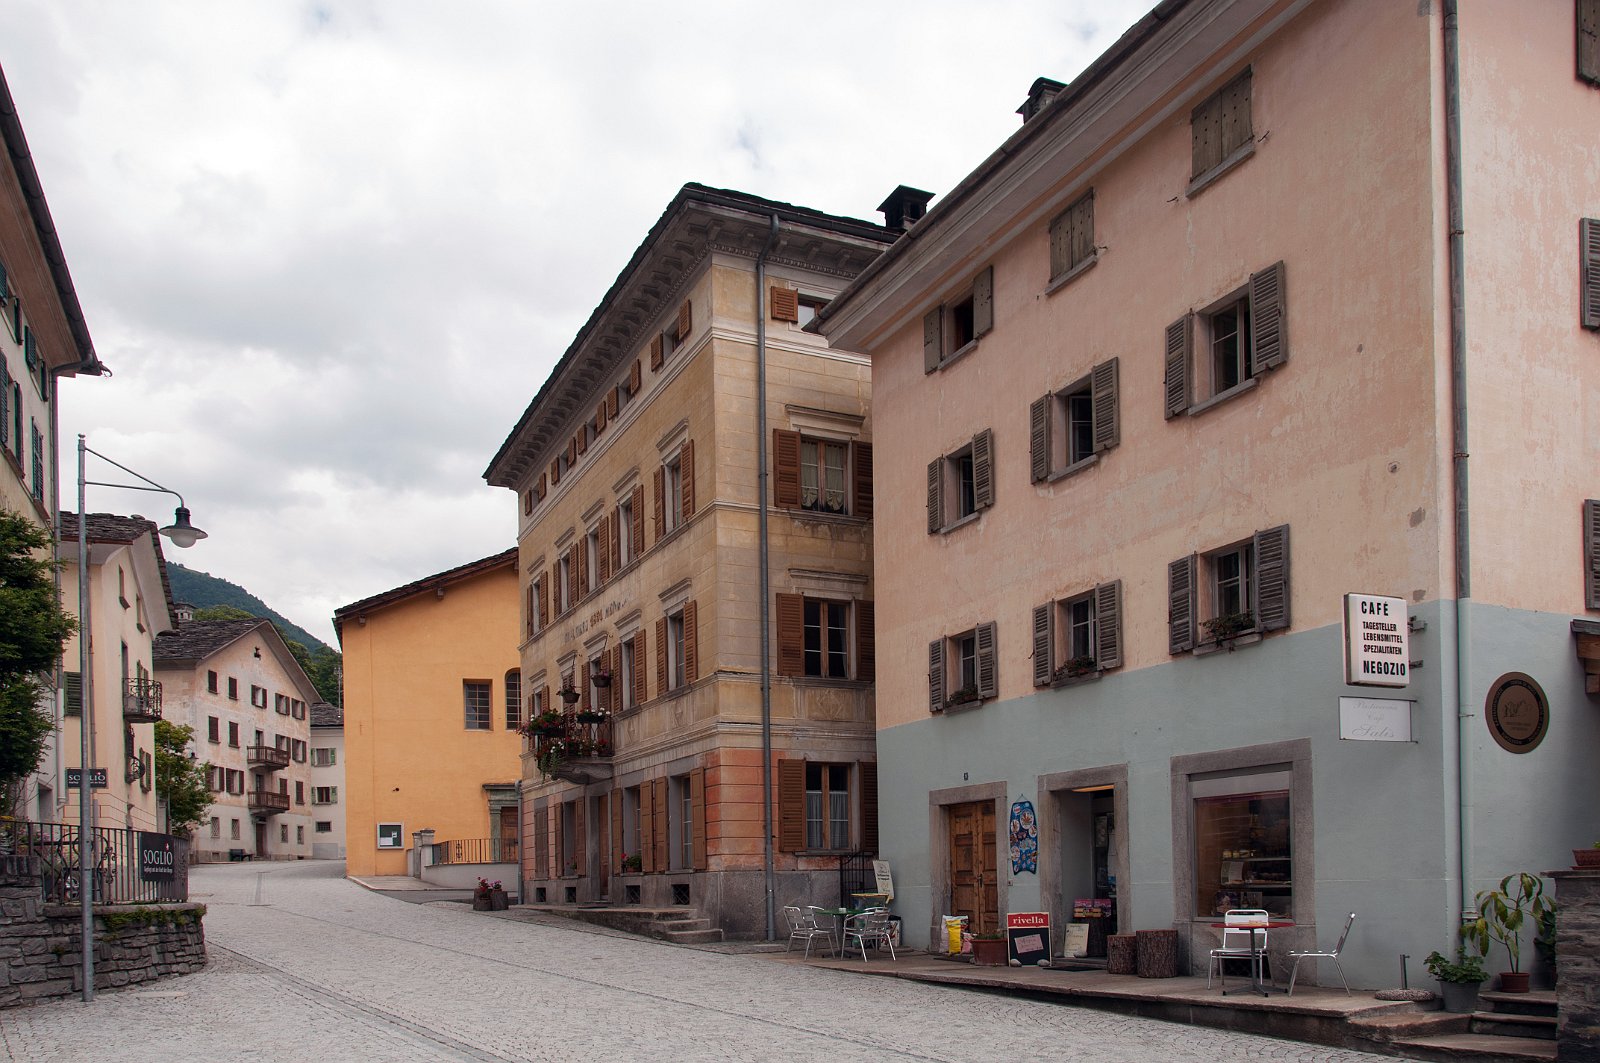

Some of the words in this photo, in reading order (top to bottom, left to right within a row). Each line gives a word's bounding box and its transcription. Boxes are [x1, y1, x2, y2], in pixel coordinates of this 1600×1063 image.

[1361, 601, 1389, 616] CAFÉ
[1363, 621, 1397, 632] TAGESTELLER
[1363, 632, 1403, 643] LEBENSMITTEL
[1363, 660, 1406, 676] NEGOZIO
[143, 849, 173, 865] SOGLIO
[1013, 916, 1044, 924] rivella
